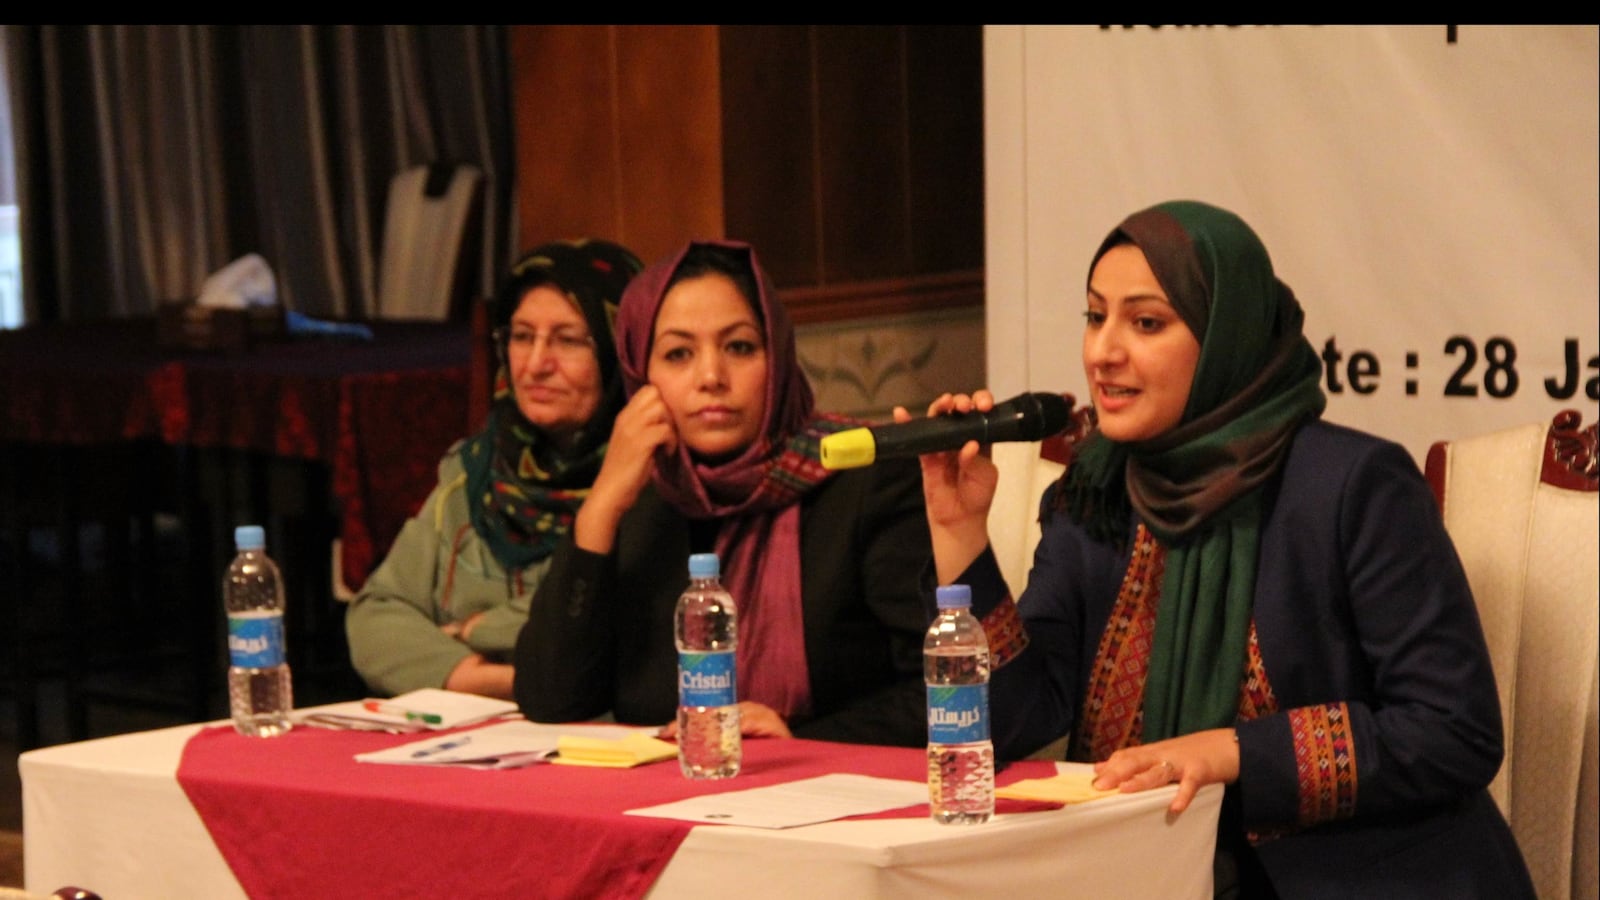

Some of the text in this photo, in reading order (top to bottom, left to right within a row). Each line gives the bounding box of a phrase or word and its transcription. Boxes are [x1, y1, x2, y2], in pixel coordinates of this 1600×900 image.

[1321, 335, 1381, 395] te
[1443, 335, 1520, 399] 28
[680, 670, 731, 689] Cristal
